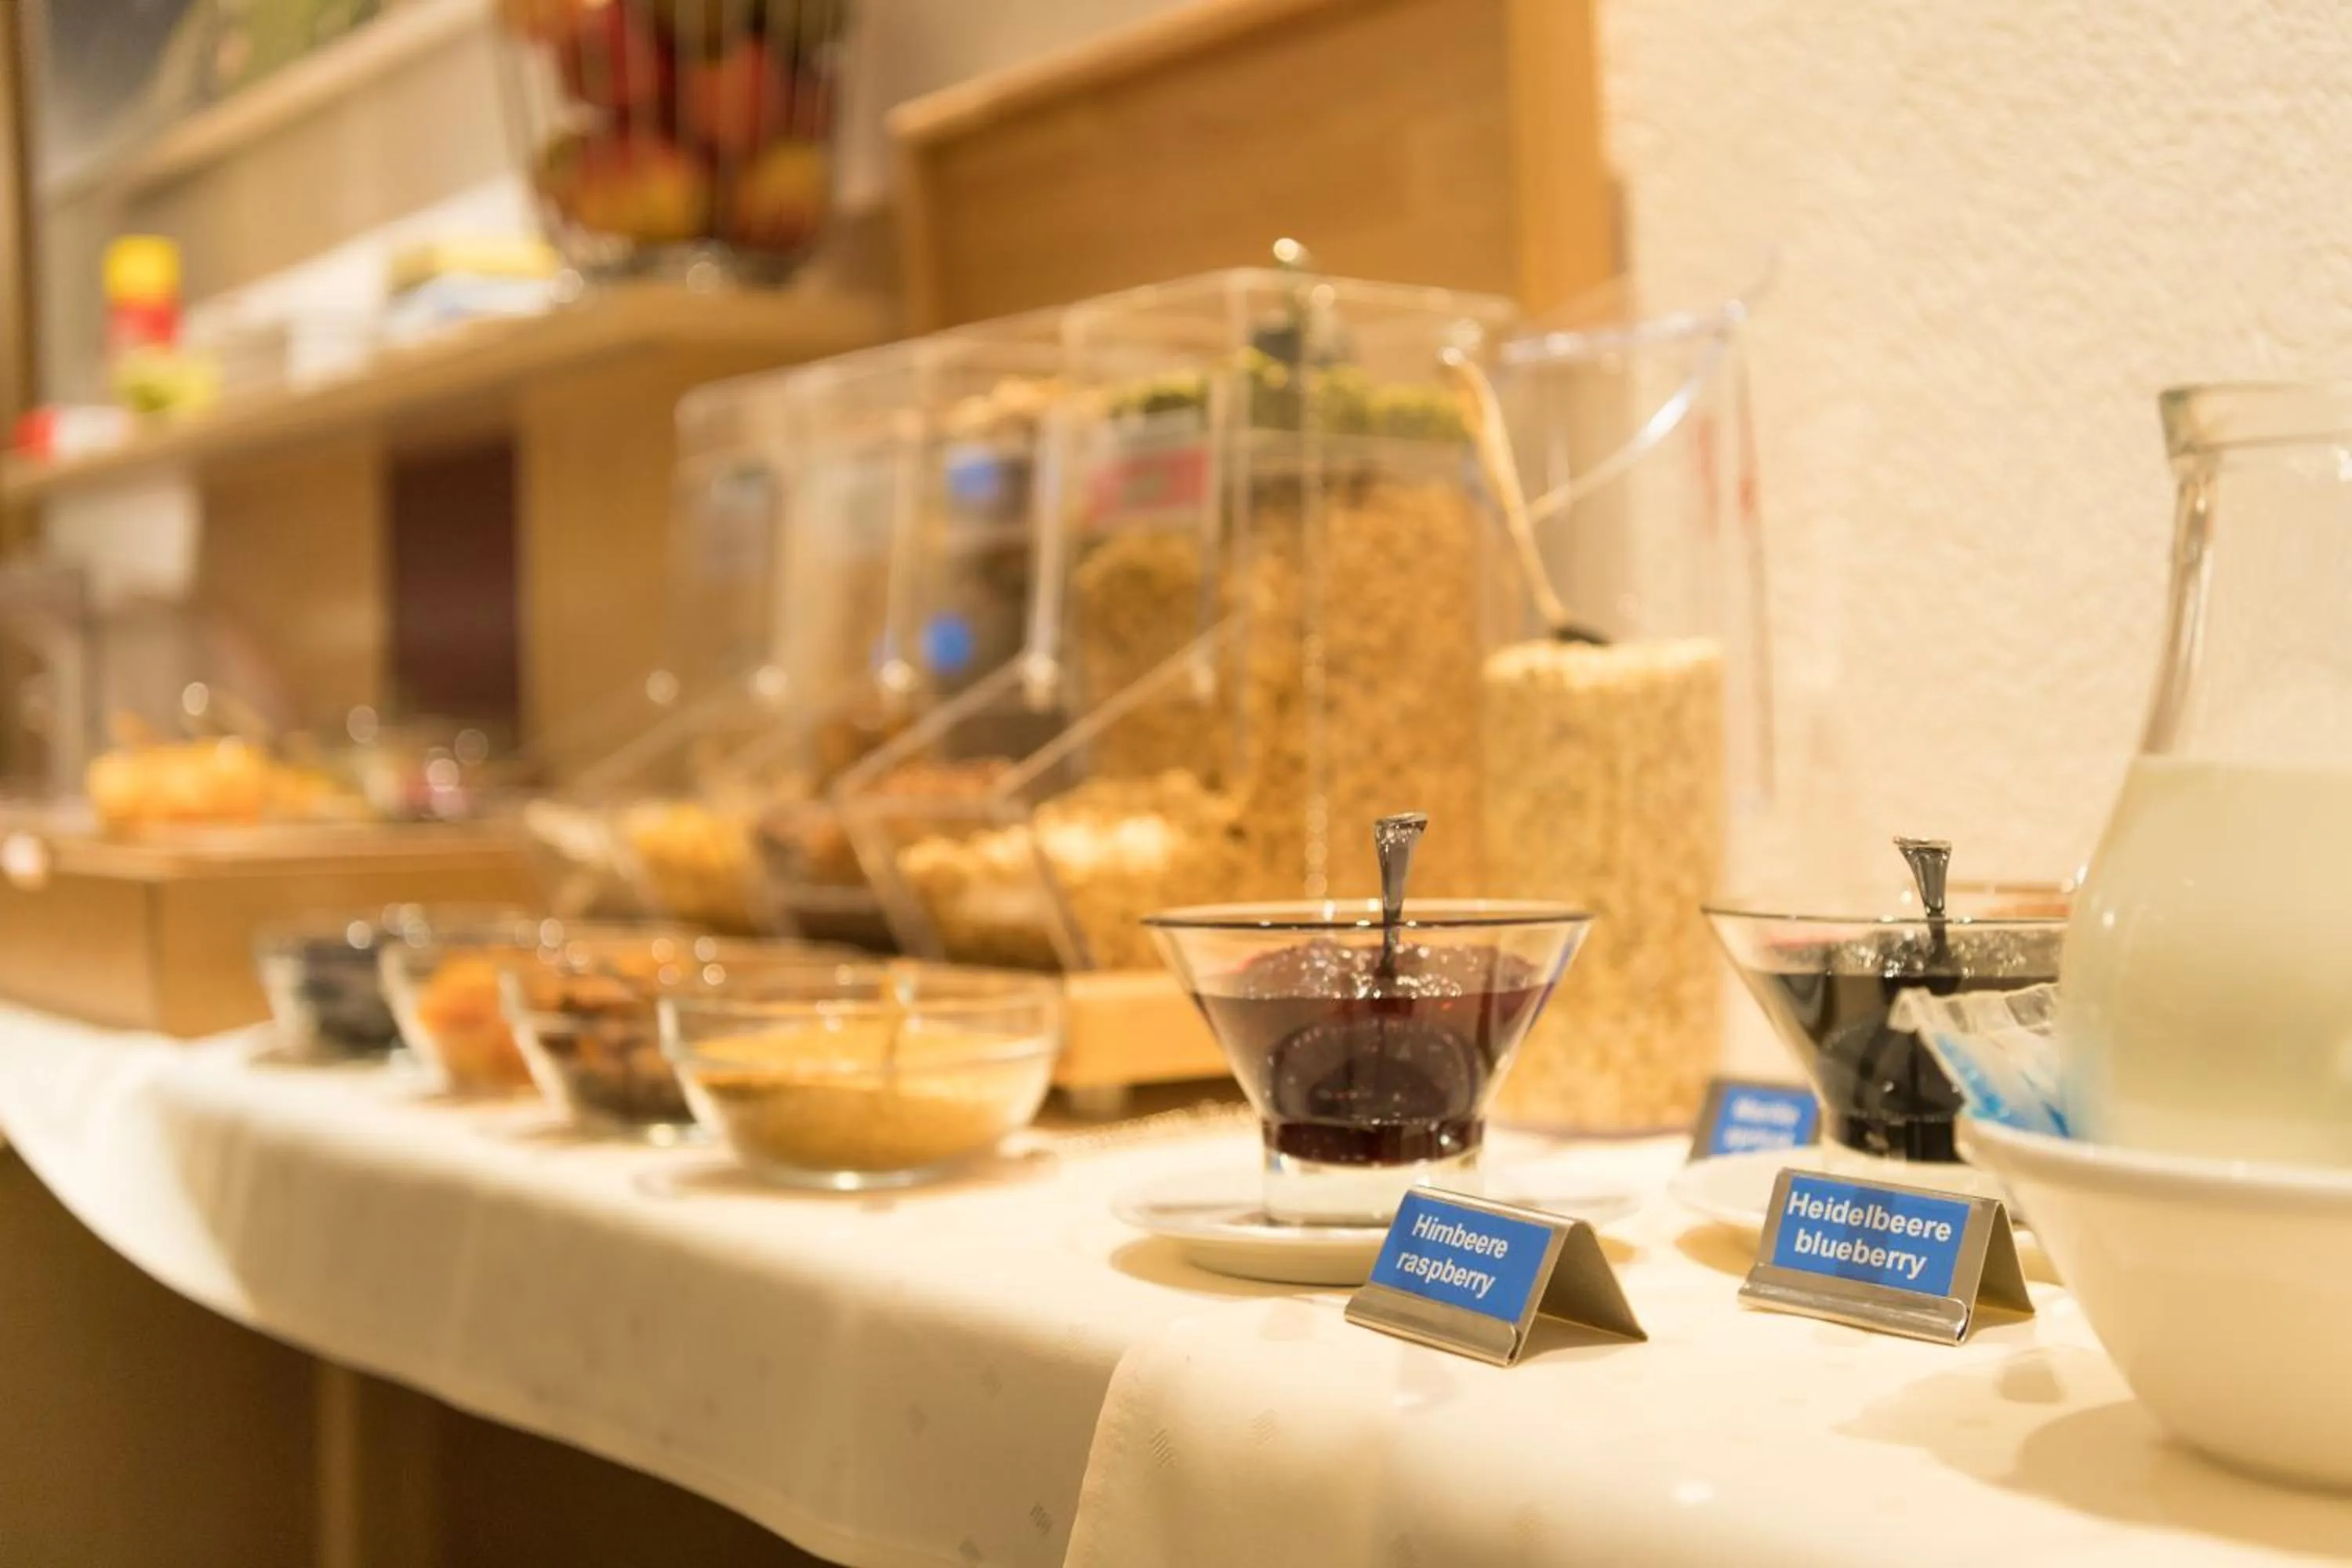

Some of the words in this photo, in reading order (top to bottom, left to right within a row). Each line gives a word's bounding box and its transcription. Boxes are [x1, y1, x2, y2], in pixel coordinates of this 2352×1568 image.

[1412, 1213, 1508, 1260] Himbeere
[1787, 1190, 1952, 1243] Heidelbeere
[1396, 1251, 1497, 1299] raspberry
[1794, 1229, 1926, 1280] blueberry
